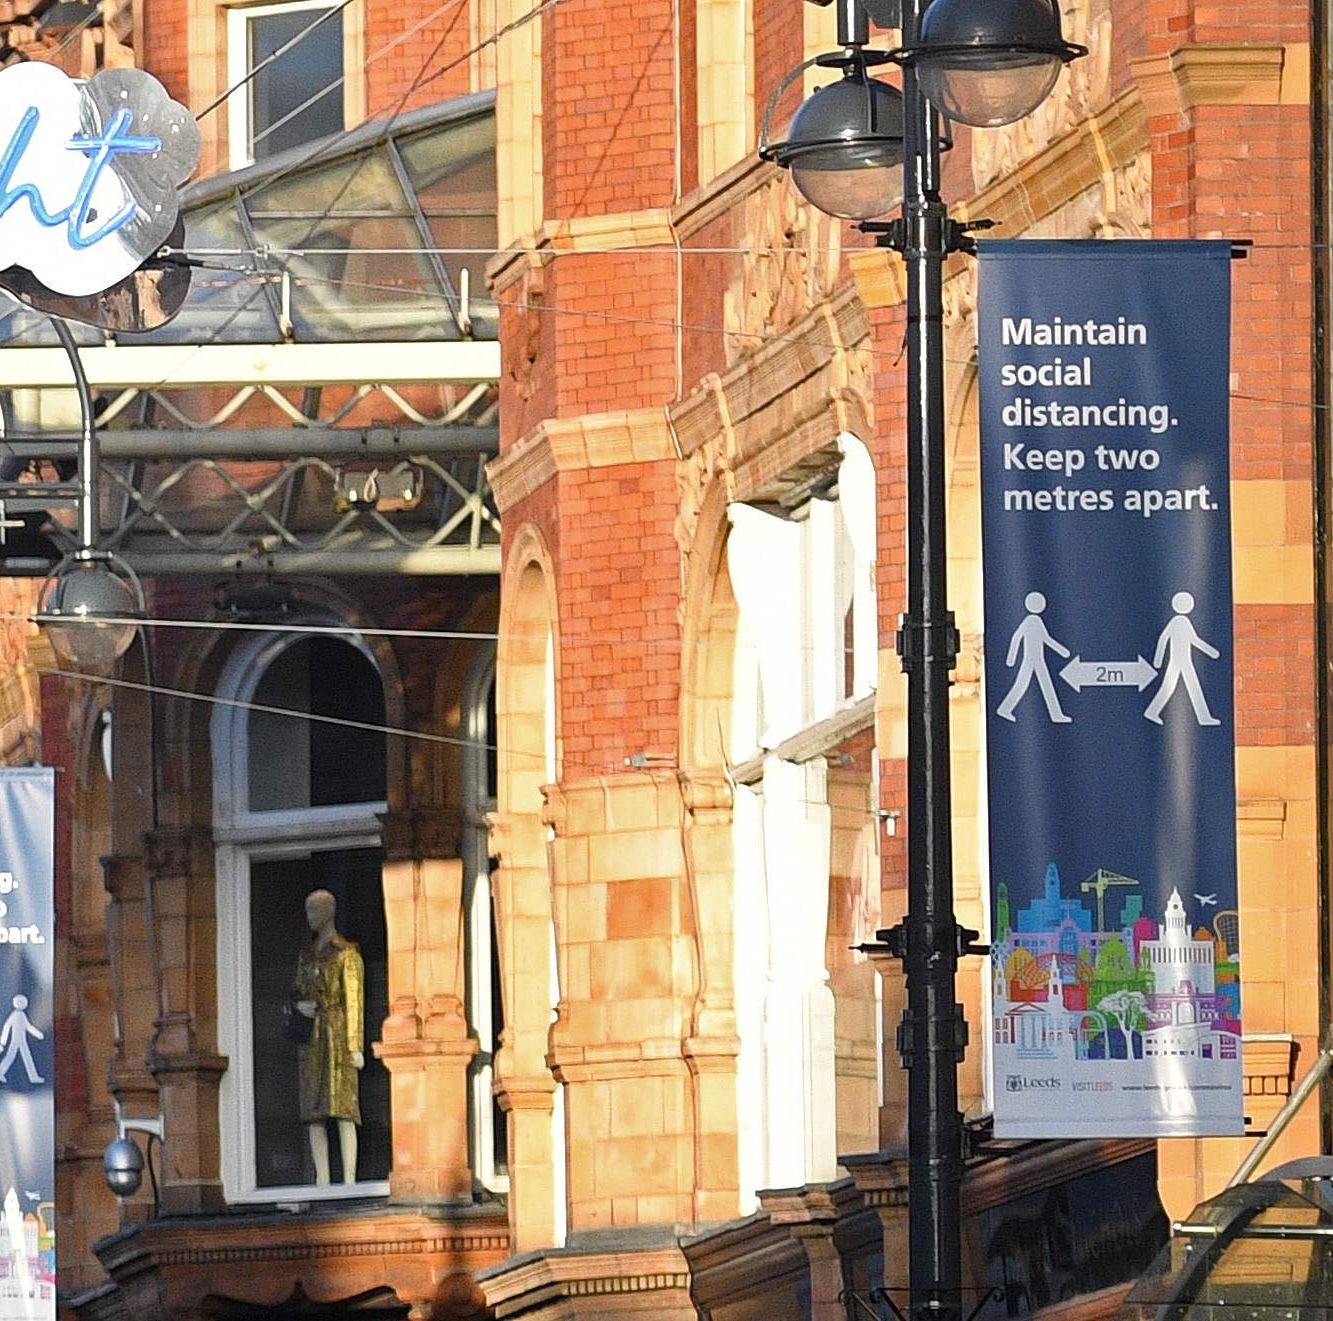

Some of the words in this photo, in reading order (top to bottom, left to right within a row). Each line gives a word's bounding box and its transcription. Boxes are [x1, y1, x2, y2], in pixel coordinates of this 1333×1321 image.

[1001, 317, 1147, 346] Maintain
[1001, 357, 1091, 386] social
[1001, 398, 1179, 433] distancing.
[1003, 443, 1085, 477] Keep
[1094, 445, 1160, 471] two
[1003, 486, 1114, 511] metres
[1123, 484, 1219, 518] apart.
[1096, 666, 1125, 683] 2m
[1023, 1076, 1061, 1089] Leeds
